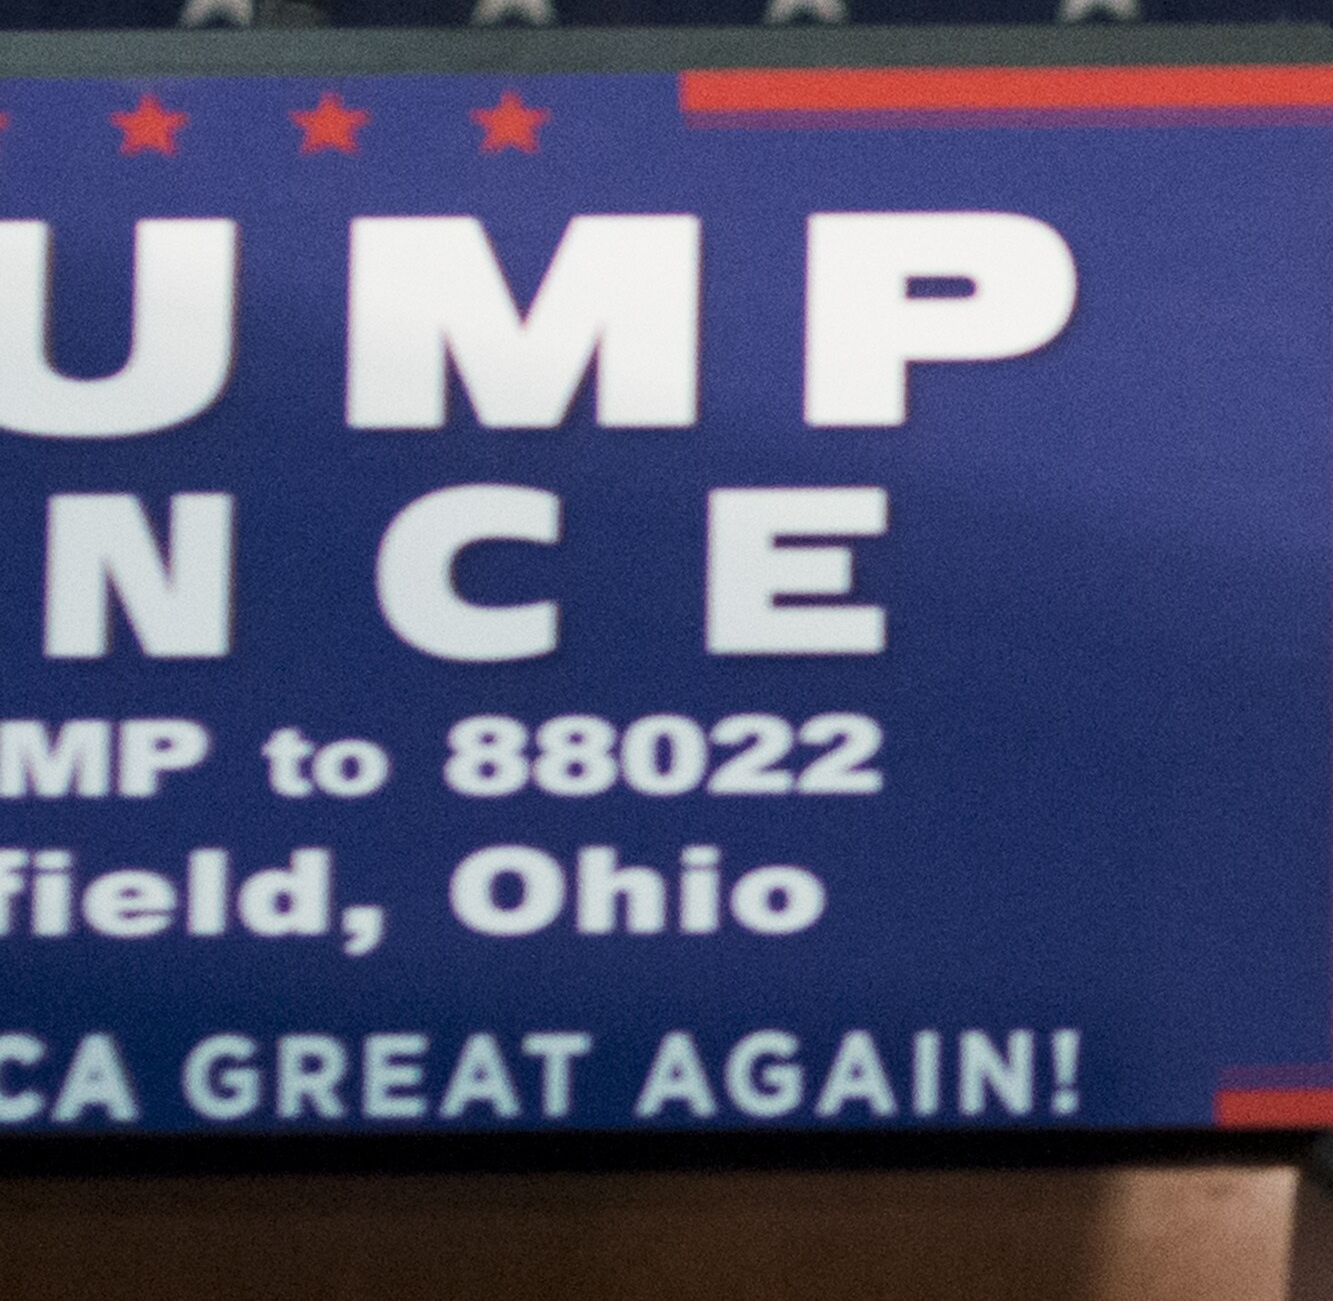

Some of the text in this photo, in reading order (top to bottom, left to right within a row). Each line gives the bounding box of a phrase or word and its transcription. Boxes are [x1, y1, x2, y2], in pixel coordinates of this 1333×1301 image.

[0, 213, 1077, 437] UMP
[43, 484, 888, 661] NCE
[0, 713, 883, 798] MP to 88022
[449, 845, 826, 936] Ohio
[0, 1029, 1079, 1122] CA GREAT AGAIN!
